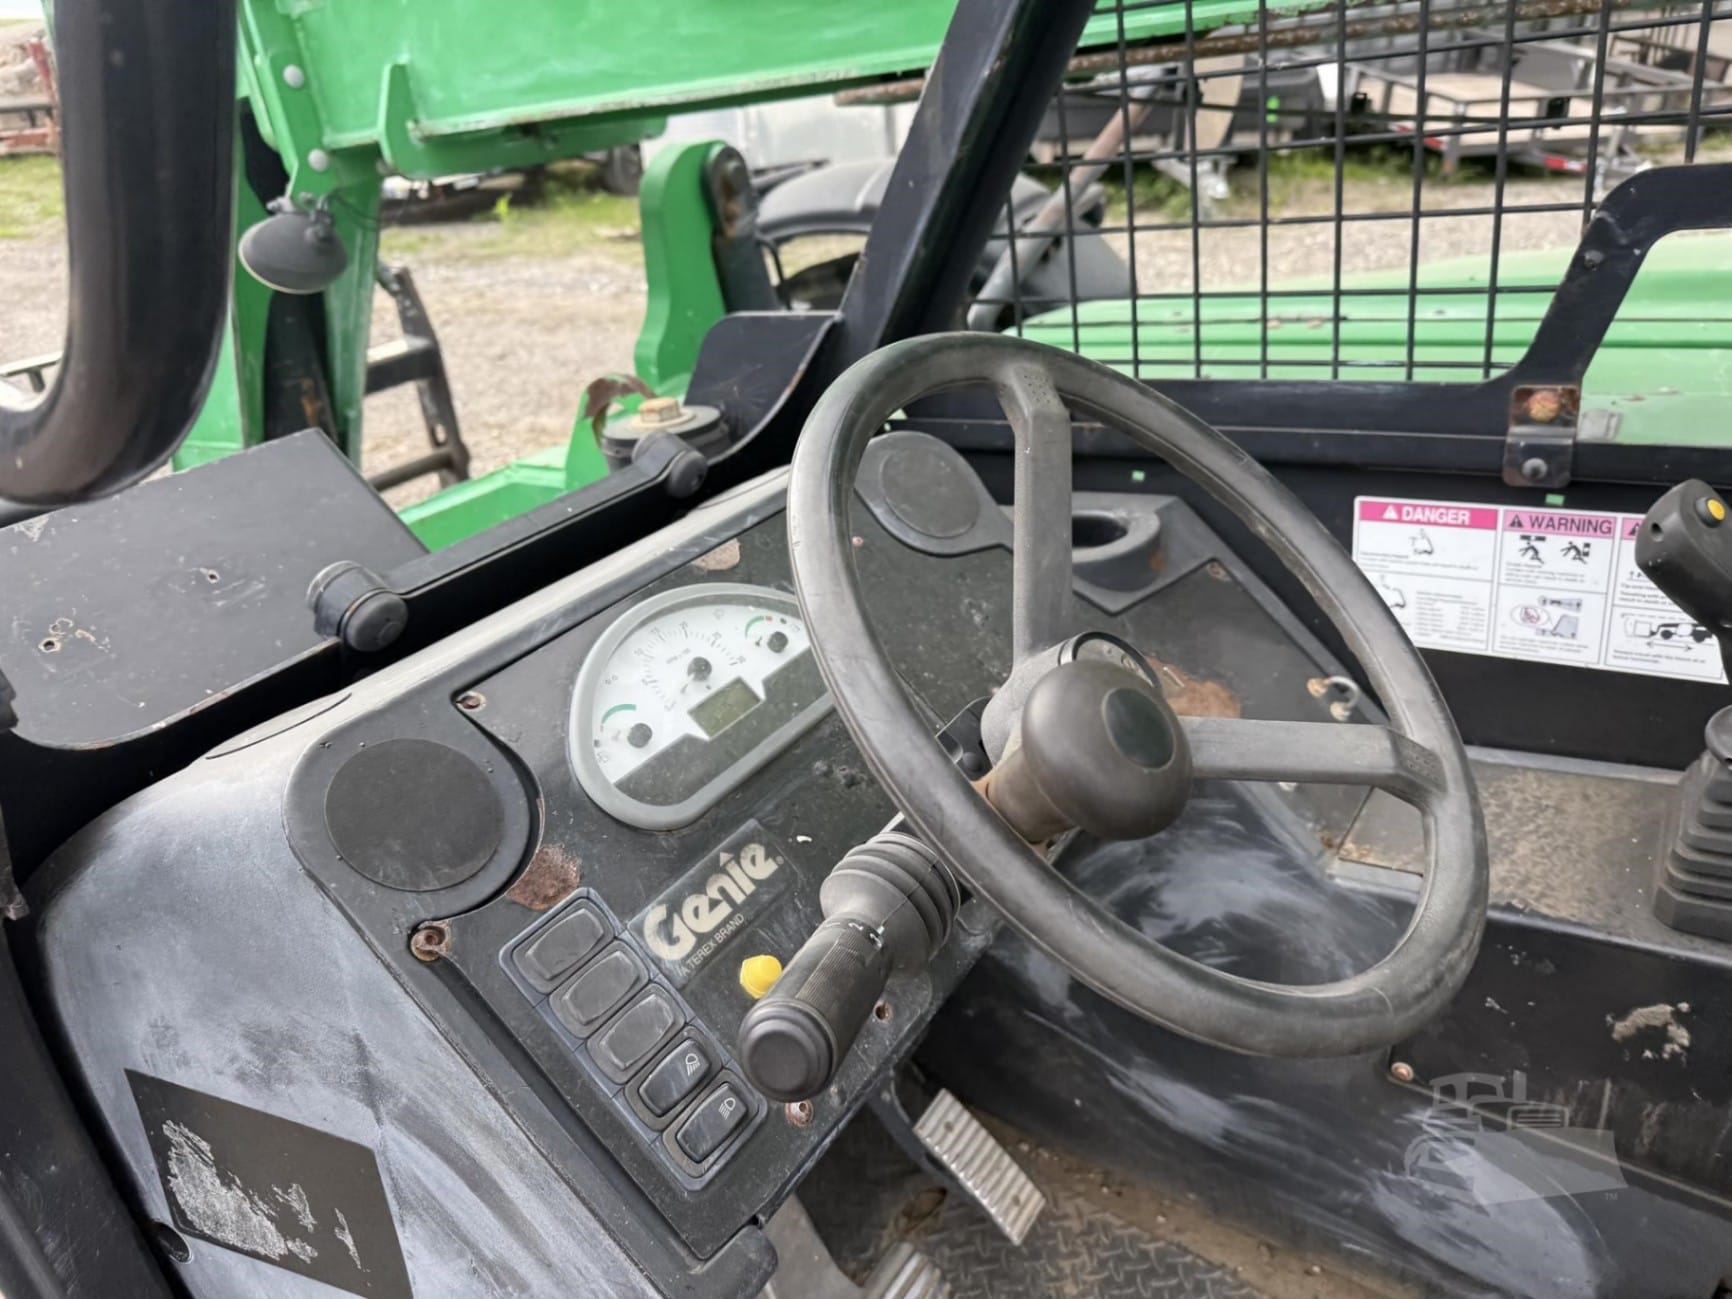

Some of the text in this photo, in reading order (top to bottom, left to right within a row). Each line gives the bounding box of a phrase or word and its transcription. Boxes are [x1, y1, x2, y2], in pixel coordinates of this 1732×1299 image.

[1402, 506, 1471, 526] DANGER
[1528, 514, 1613, 535] WARNING
[686, 938, 718, 969] TEREX
[713, 913, 745, 944] BRAND
